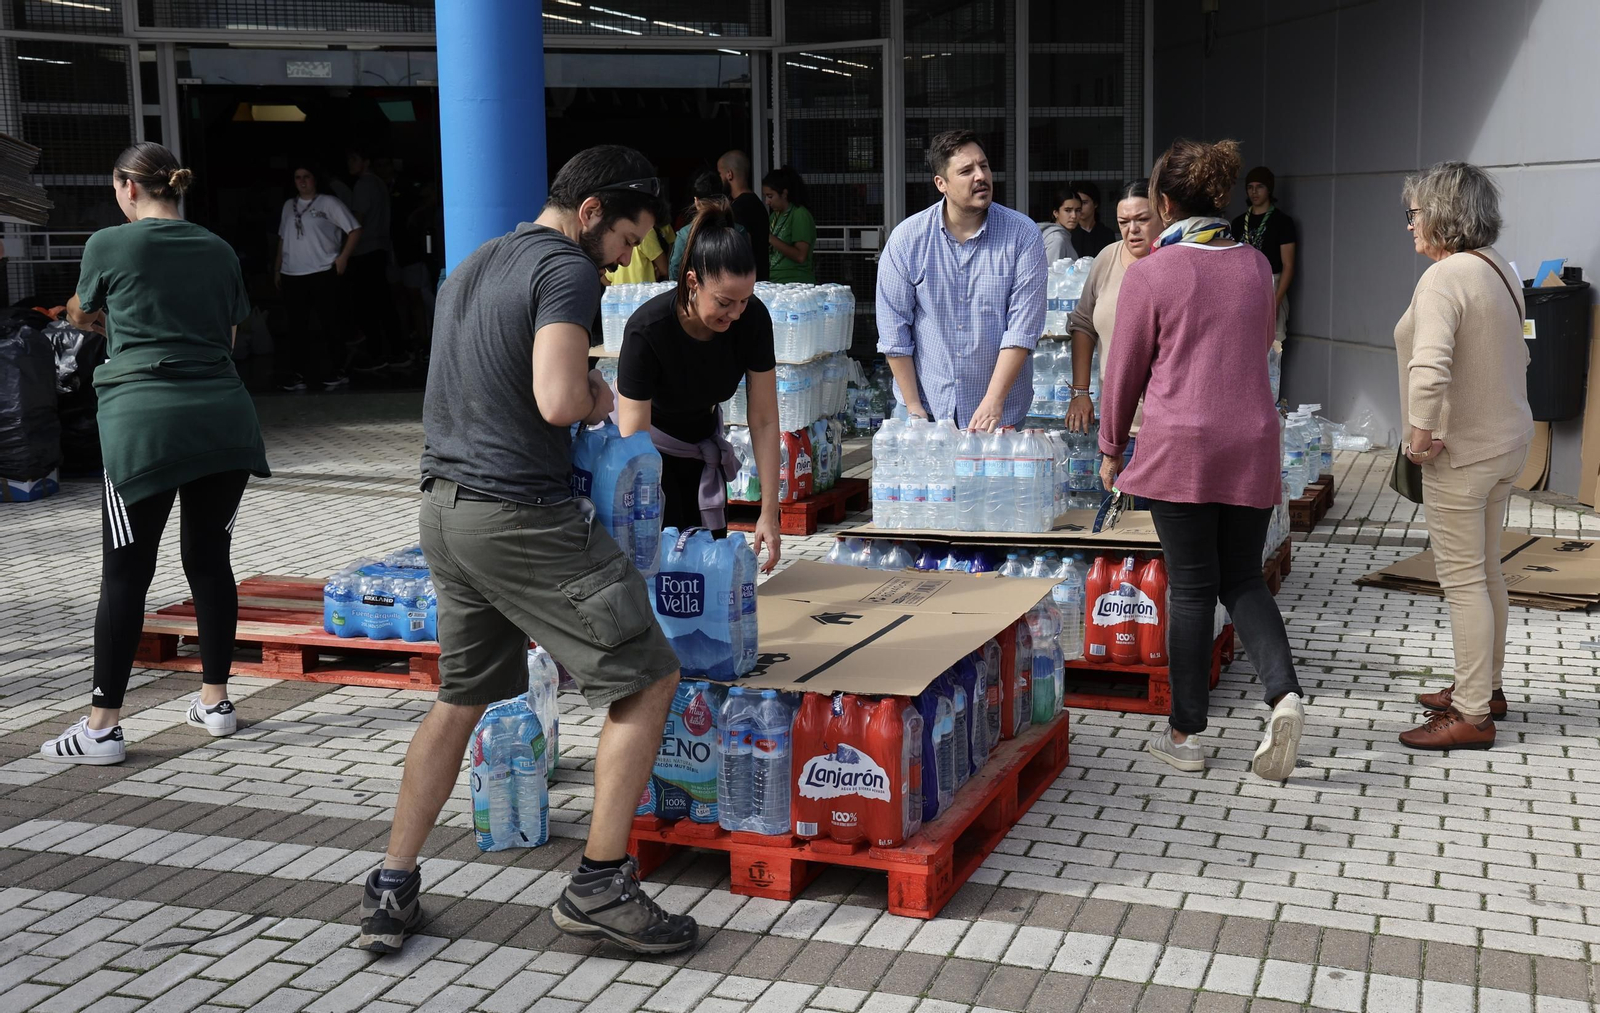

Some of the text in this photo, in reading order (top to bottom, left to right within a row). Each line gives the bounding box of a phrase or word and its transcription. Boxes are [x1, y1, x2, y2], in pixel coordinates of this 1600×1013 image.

[661, 576, 699, 594] Font
[660, 594, 700, 613] Vella
[1097, 598, 1153, 616] Lanjarón
[1116, 633, 1135, 642] 100%
[658, 737, 710, 763] ENO
[805, 762, 884, 789] Lanjarón
[665, 798, 686, 807] 100%
[831, 811, 858, 822] 100%
